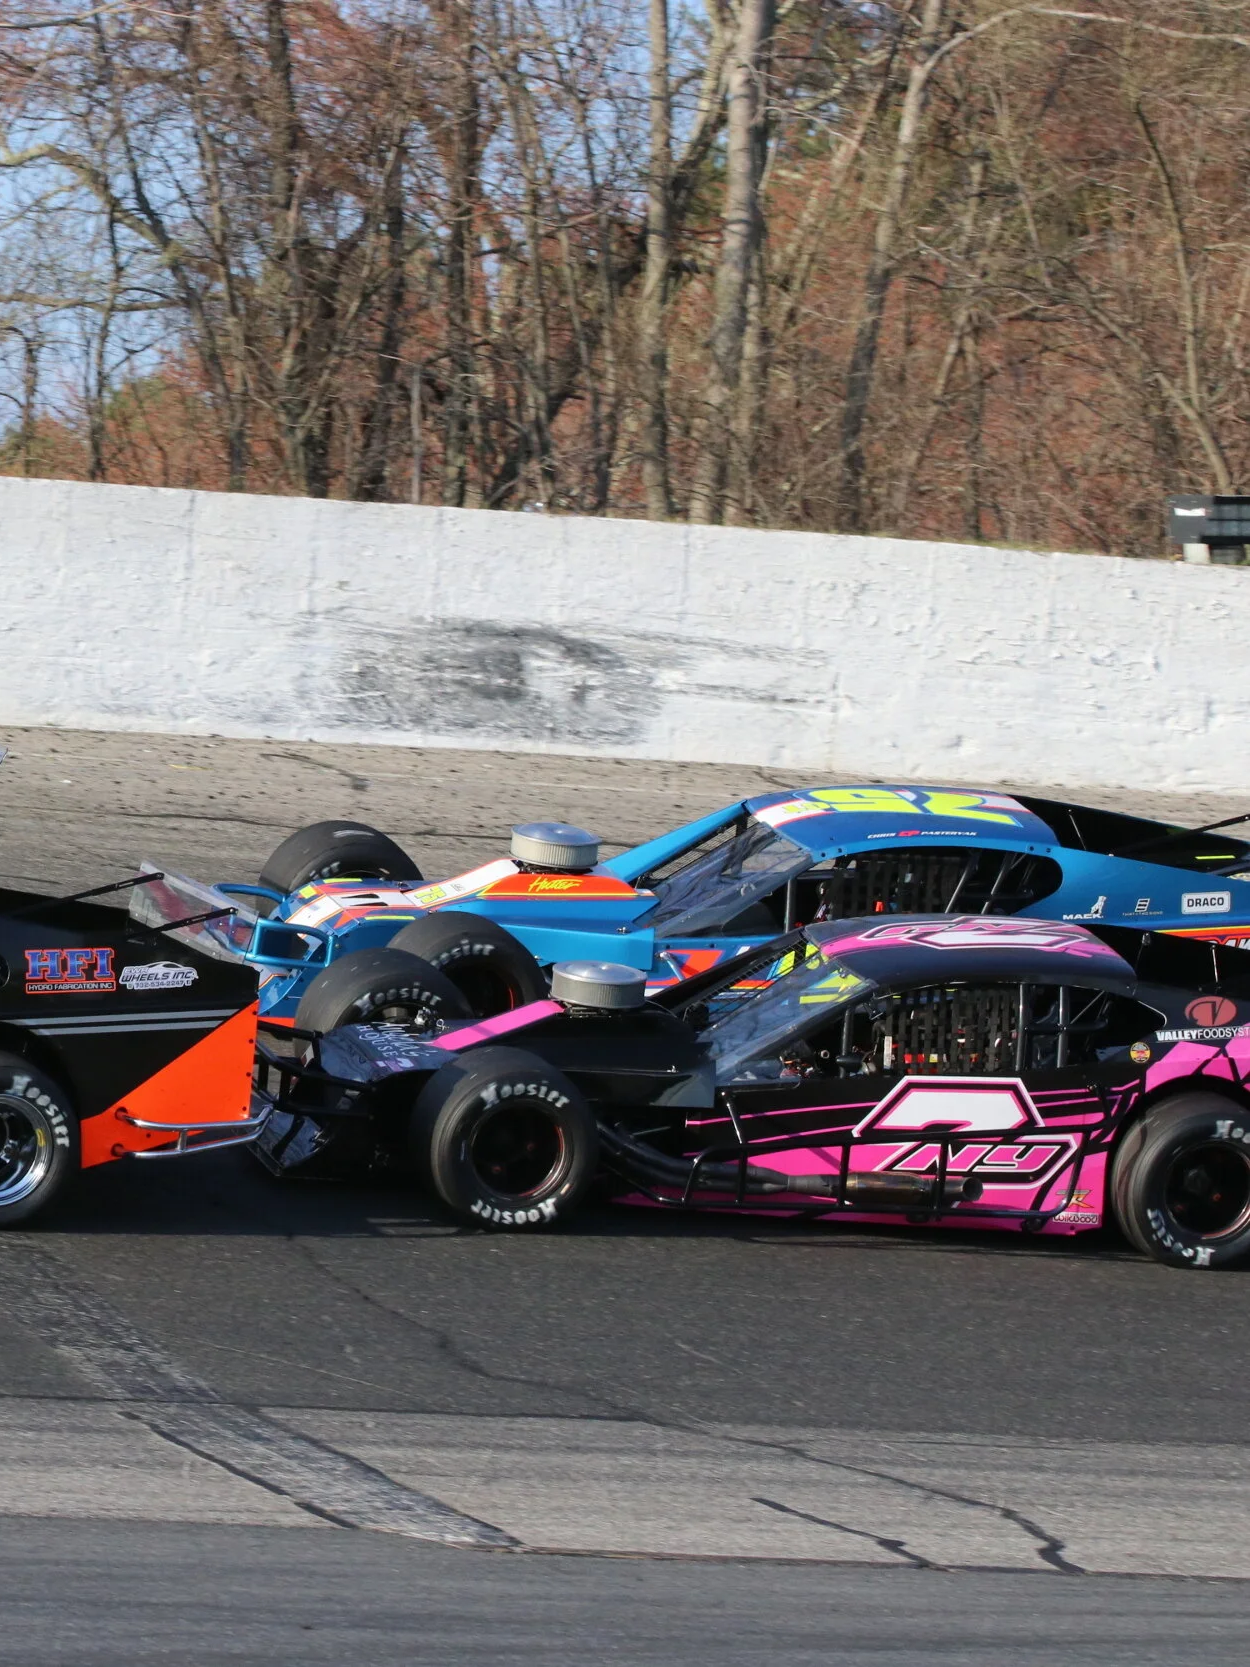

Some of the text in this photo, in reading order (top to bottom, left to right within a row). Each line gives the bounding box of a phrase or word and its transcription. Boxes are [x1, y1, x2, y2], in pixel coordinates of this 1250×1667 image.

[1186, 896, 1225, 908] DRACO
[25, 948, 116, 982] HFI
[121, 972, 171, 982] WHEELS
[54, 982, 99, 990] FABRICATION
